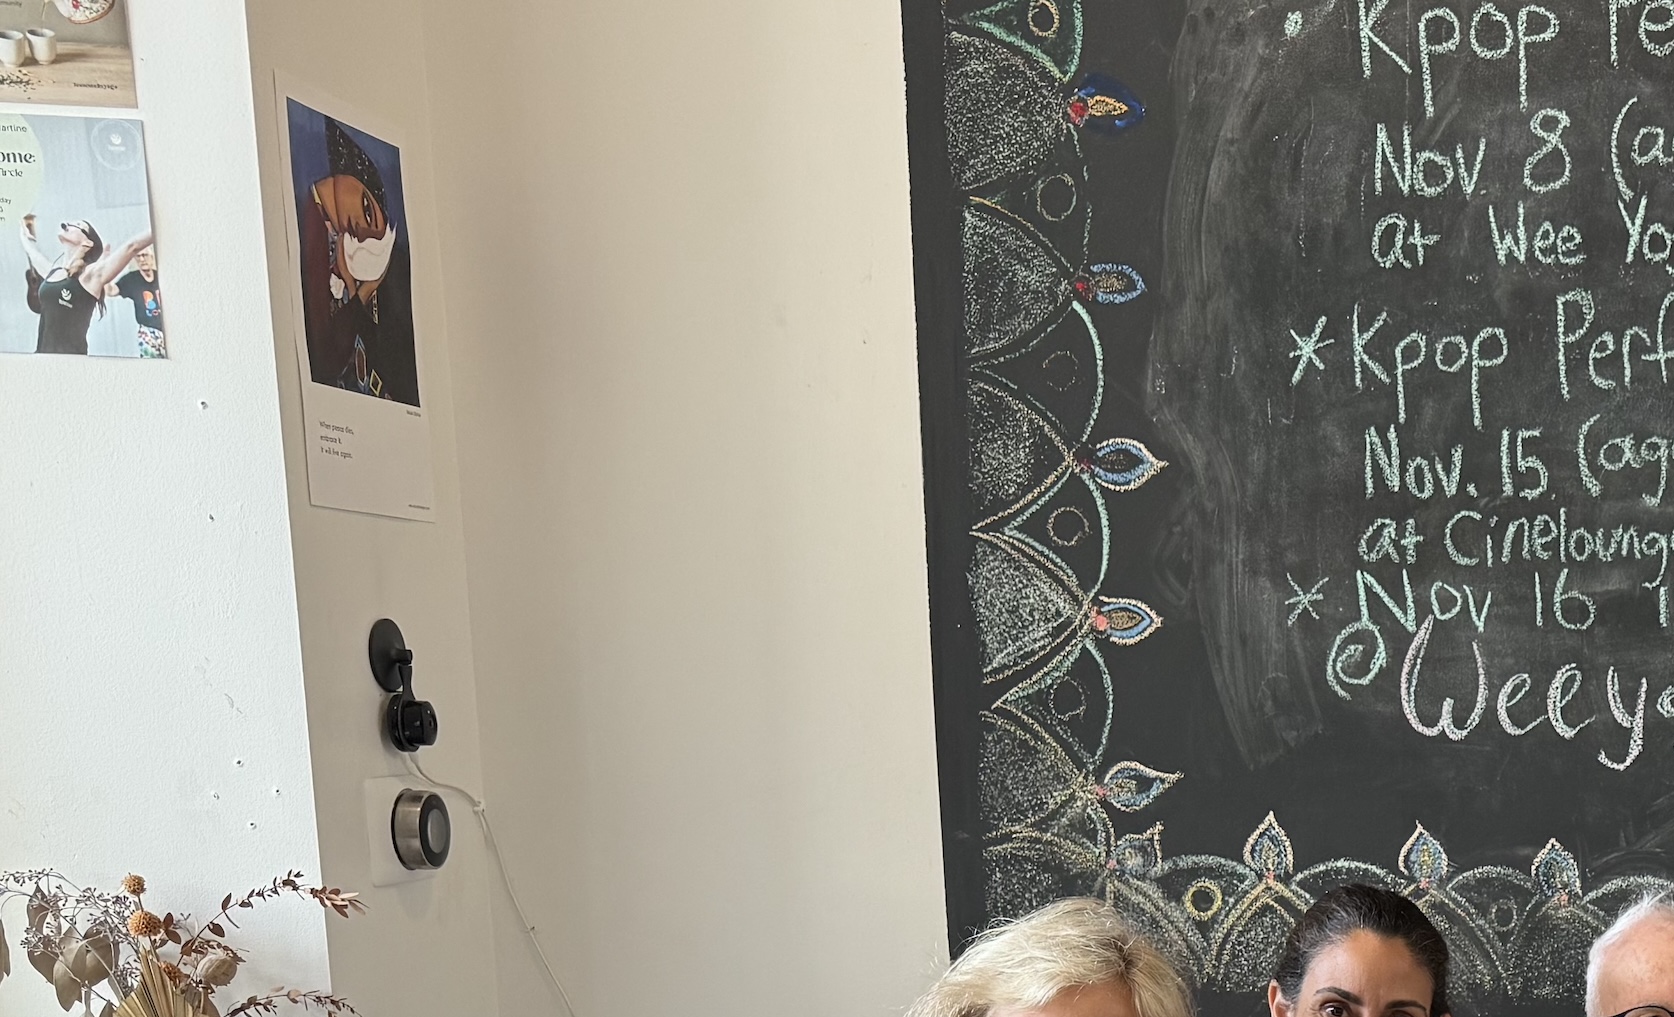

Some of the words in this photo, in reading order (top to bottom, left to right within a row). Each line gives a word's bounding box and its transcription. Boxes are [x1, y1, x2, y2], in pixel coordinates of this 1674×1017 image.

[1357, 0, 1561, 119] Kpop
[1373, 121, 1487, 199] Nov
[1523, 108, 1572, 194] 8
[1371, 213, 1441, 269] at
[1490, 202, 1586, 267] Wee
[1352, 303, 1508, 430] Kpop
[1364, 424, 1478, 499] Nov.
[1357, 518, 1424, 566] at
[1356, 568, 1492, 634] Nov
[1534, 568, 1597, 629] 16
